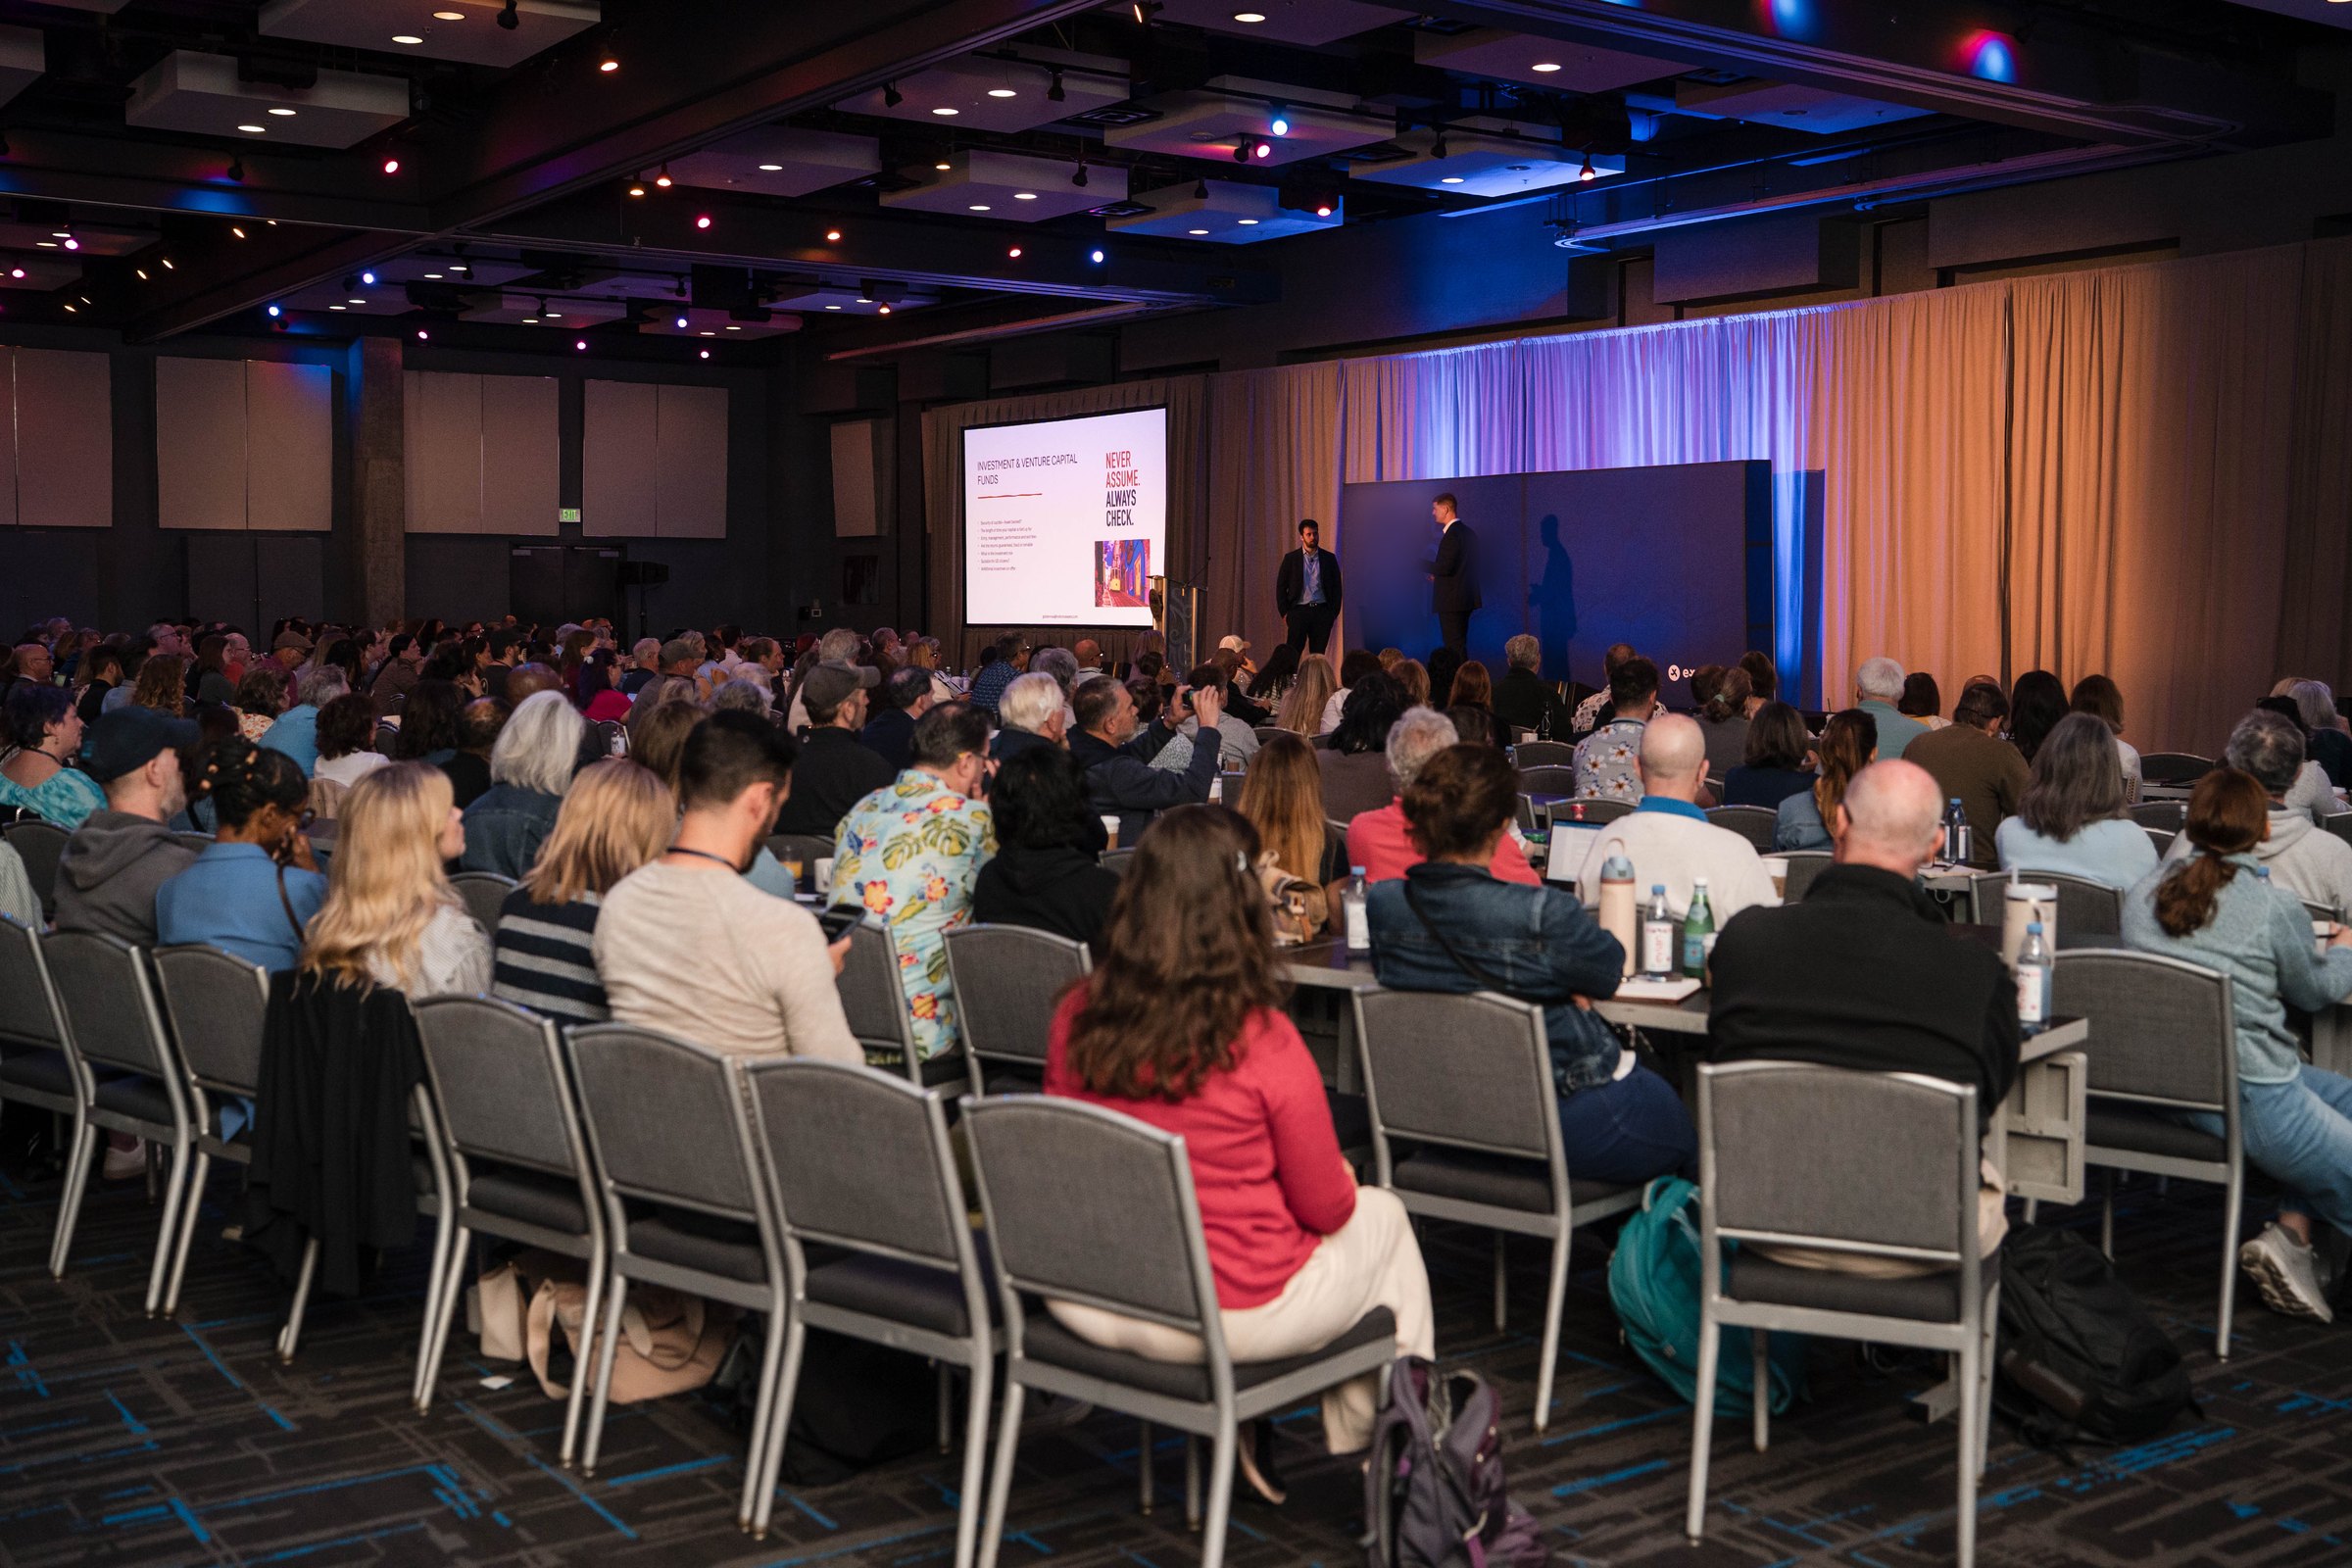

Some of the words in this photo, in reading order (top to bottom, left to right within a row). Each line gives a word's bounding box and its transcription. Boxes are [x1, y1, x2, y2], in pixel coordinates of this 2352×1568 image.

[977, 460, 1014, 471] INVESTMENT
[1015, 458, 1020, 468] &
[1021, 456, 1051, 468] VENTURE
[1051, 454, 1078, 466] CAPITAL
[1105, 451, 1131, 468] NEVER
[977, 474, 999, 485] FUNDS
[1105, 469, 1140, 488] ASSUME.
[1105, 489, 1137, 508] ALWAYS
[563, 510, 576, 520] EXIT
[1105, 509, 1134, 526] CHECK.
